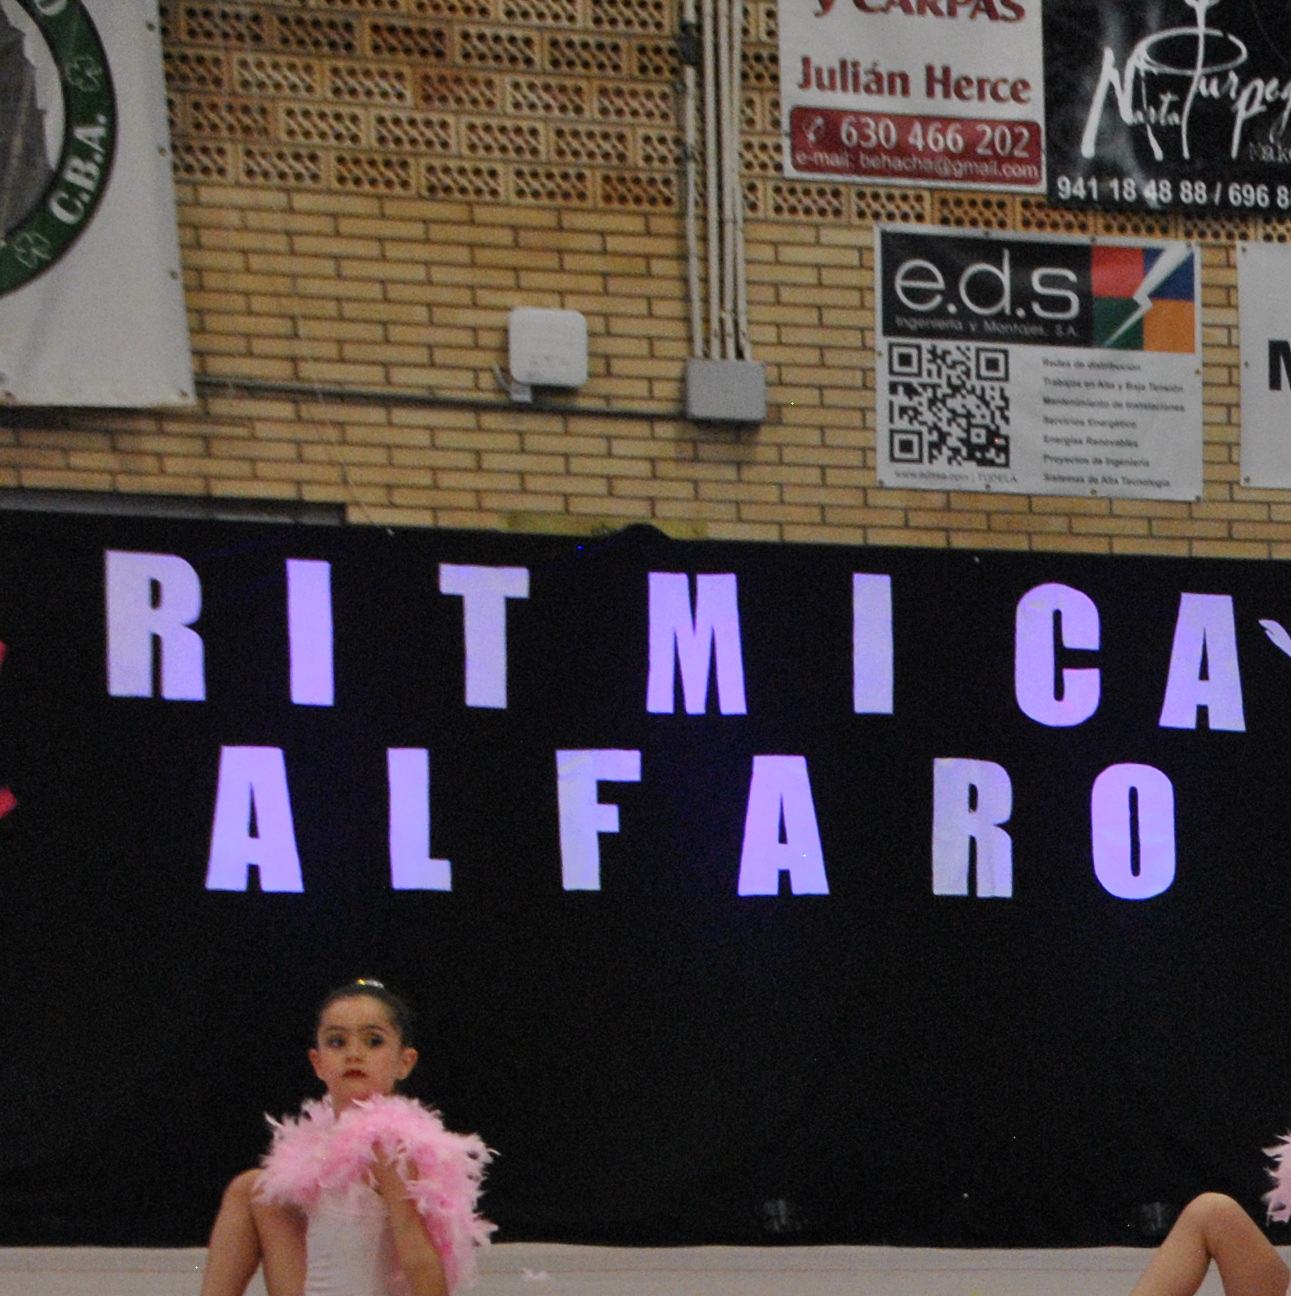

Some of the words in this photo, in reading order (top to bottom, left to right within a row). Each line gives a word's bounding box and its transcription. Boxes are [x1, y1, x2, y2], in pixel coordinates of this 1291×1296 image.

[798, 55, 911, 98] Julián
[924, 64, 1033, 104] Herce
[839, 116, 897, 150] 630
[908, 120, 965, 154] 466
[975, 124, 1031, 158] 202
[49, 113, 108, 225] C.B.A.
[1056, 175, 1100, 201] 941
[1108, 178, 1138, 202] 18
[1142, 179, 1173, 203] 48
[1179, 180, 1208, 203] 88
[1228, 183, 1271, 209] 696
[893, 248, 1081, 321] e.d.s
